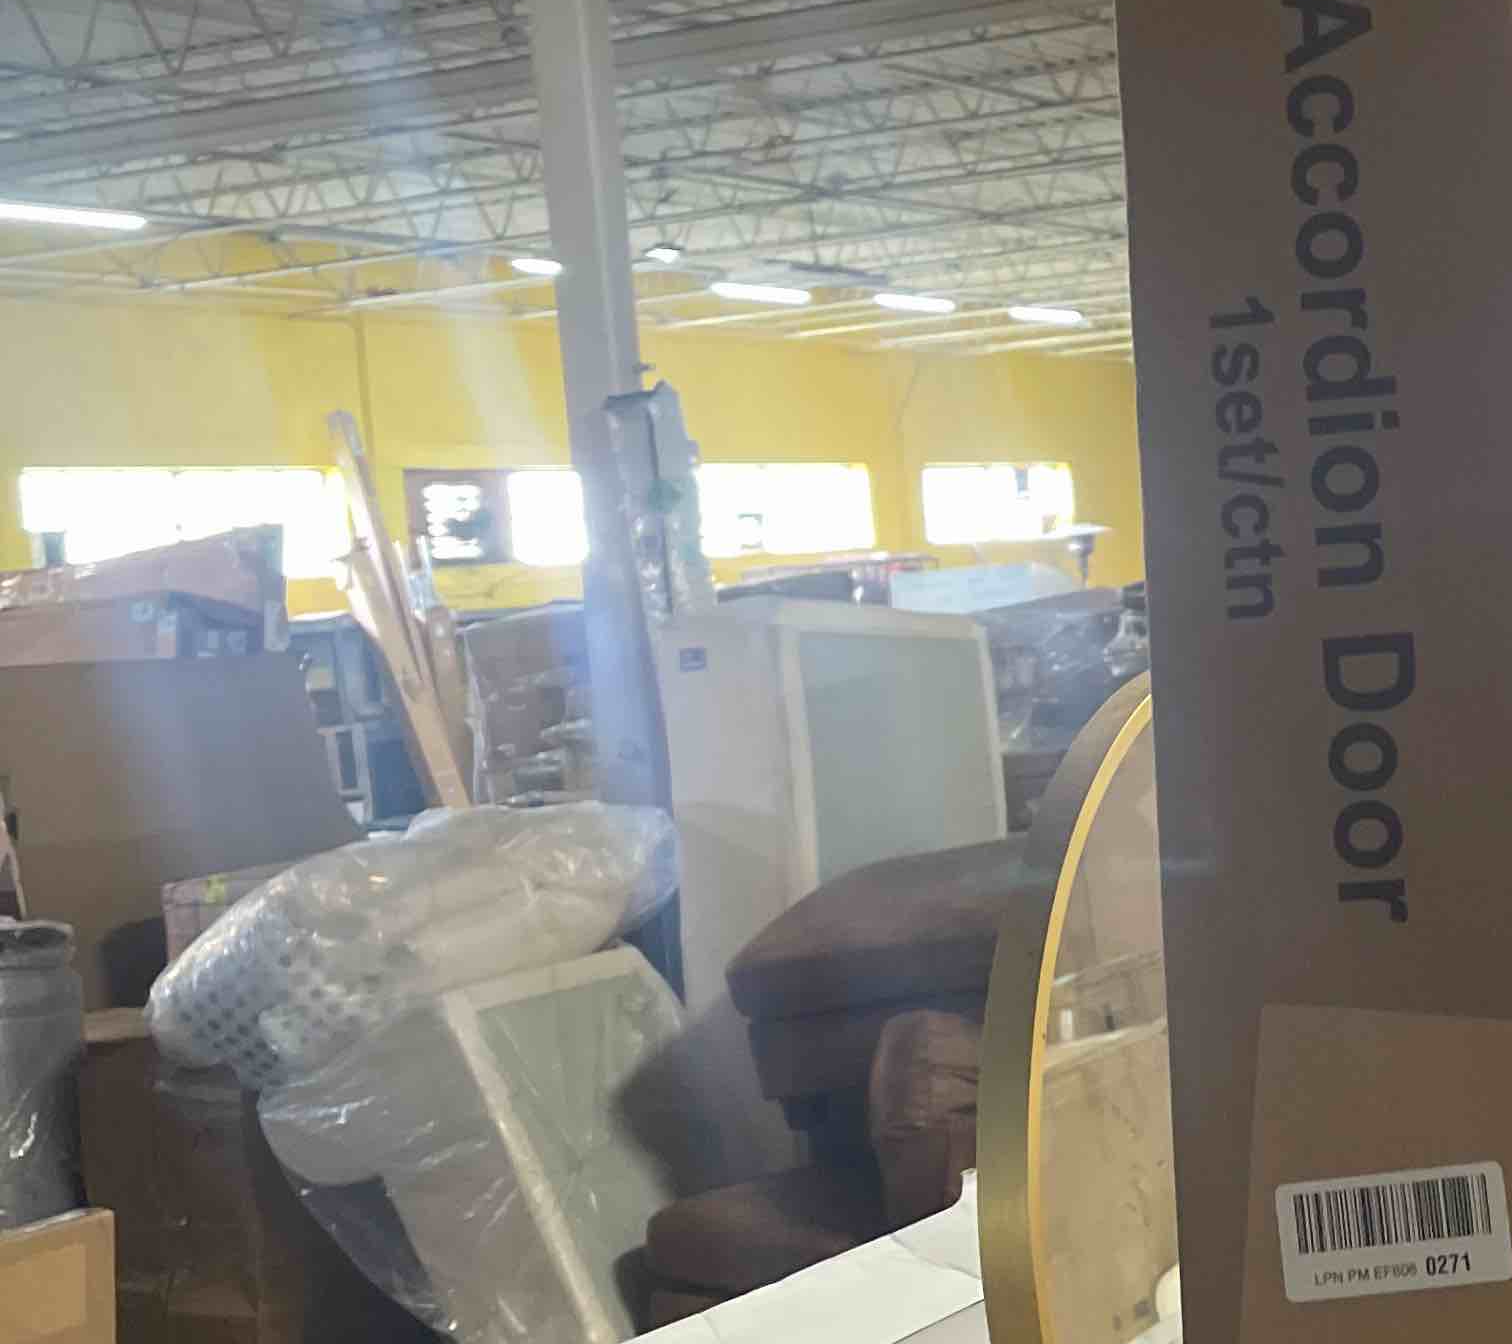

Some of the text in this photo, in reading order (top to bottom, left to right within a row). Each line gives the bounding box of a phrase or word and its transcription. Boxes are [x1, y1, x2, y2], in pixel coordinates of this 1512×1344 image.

[1209, 295, 1286, 623] 1set/ctn
[1323, 632, 1417, 923] Door
[1314, 1271, 1344, 1287] LPN
[1348, 1267, 1370, 1283] PM
[1425, 1253, 1471, 1276] 0271
